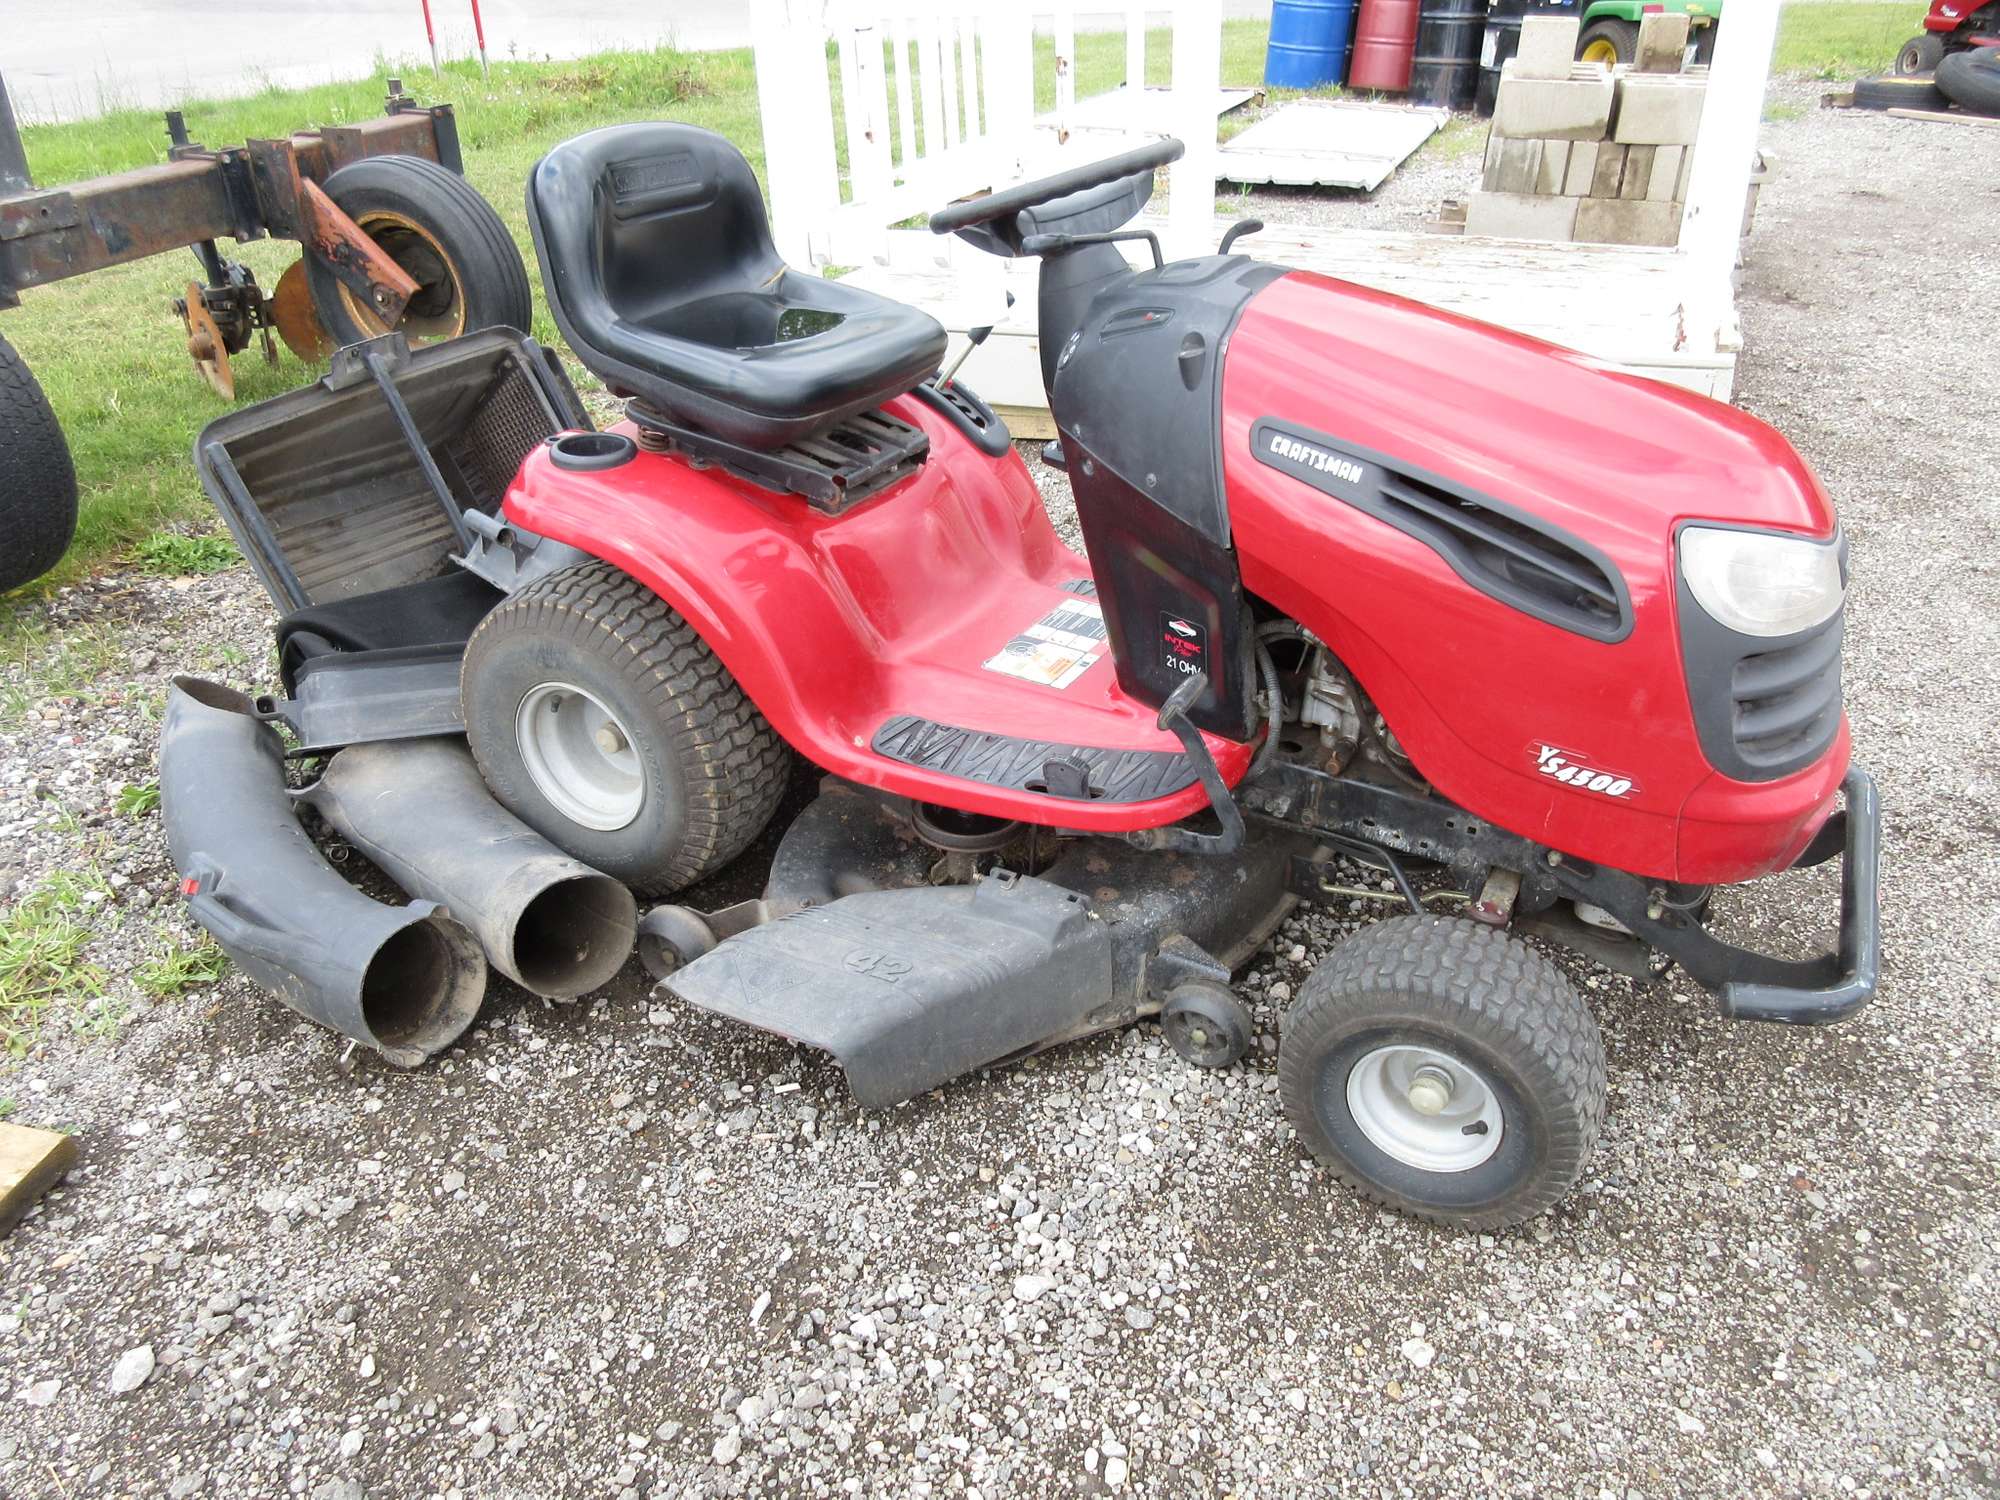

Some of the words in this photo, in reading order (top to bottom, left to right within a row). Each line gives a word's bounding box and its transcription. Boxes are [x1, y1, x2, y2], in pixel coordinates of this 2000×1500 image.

[1270, 435, 1363, 484] CRAFTSMAN
[1166, 655, 1177, 669] 21
[844, 950, 913, 983] 42
